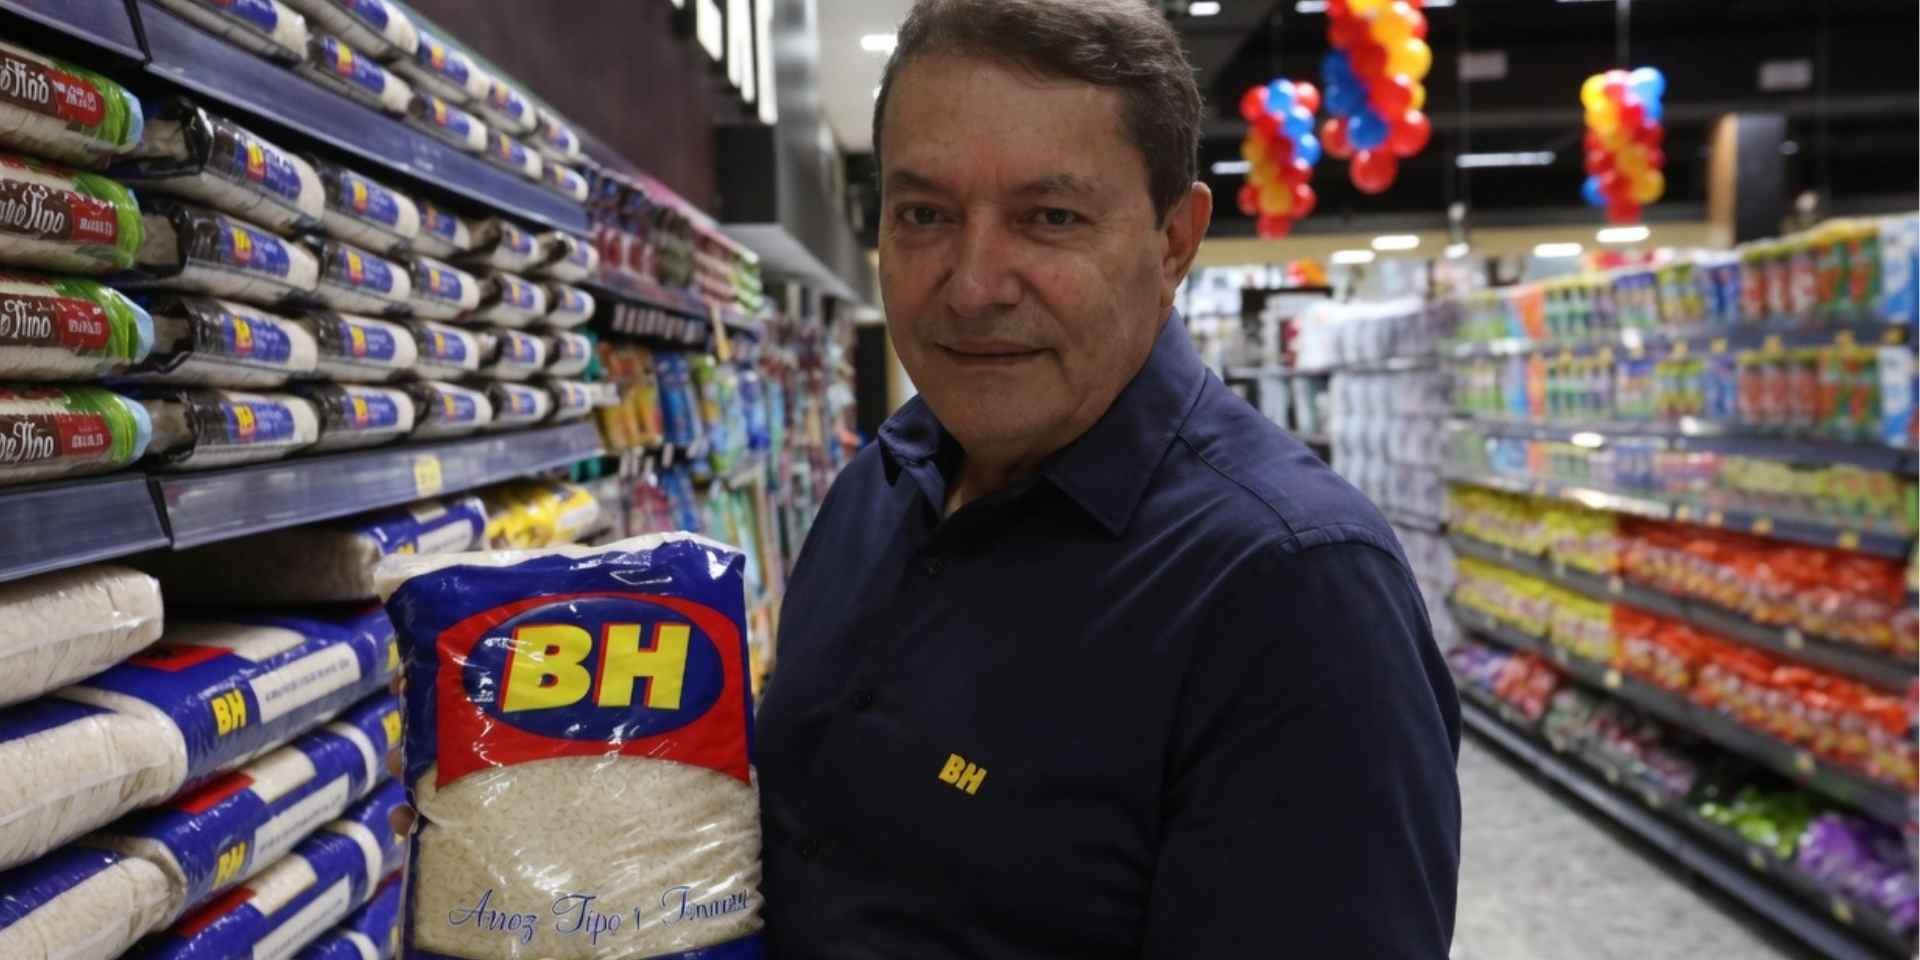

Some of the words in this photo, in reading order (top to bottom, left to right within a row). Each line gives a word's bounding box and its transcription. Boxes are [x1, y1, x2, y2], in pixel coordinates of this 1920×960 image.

[500, 623, 691, 713] BH
[211, 688, 247, 736] BH
[938, 753, 987, 795] BH
[211, 841, 247, 890] BH
[448, 888, 537, 943] Arroz
[552, 894, 622, 945] Tipo
